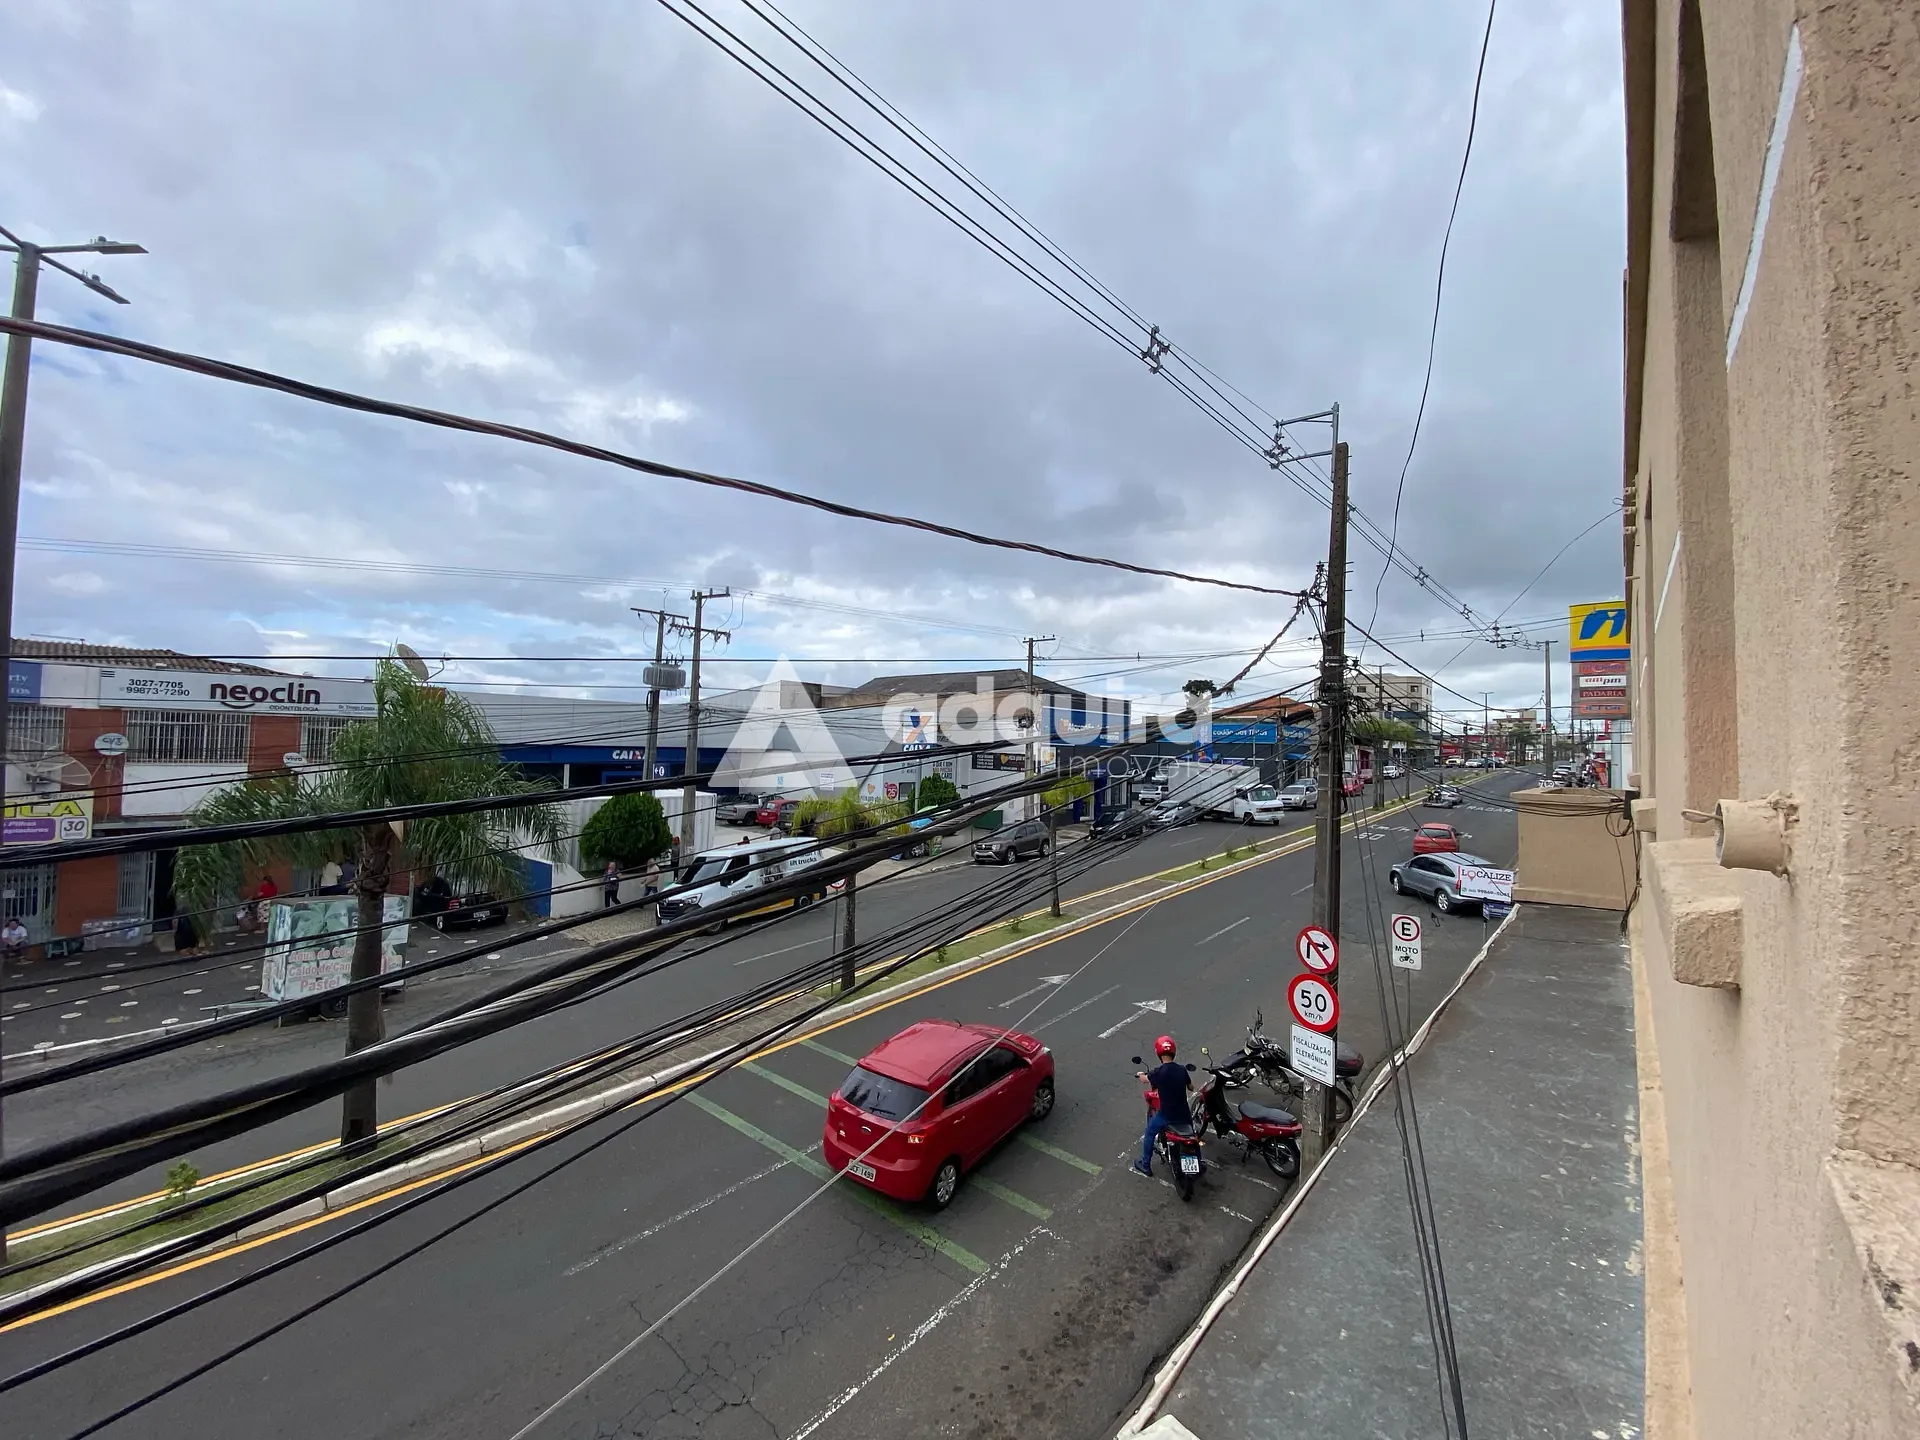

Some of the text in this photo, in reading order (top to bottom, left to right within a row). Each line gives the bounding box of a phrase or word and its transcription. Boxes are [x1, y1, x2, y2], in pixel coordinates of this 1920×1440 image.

[128, 679, 183, 689] 3027-7705
[126, 686, 190, 696] 99873-7290
[210, 682, 320, 704] neoclin
[269, 704, 319, 712] ODONTOLOGIA
[612, 750, 646, 760] CAIX
[64, 821, 85, 832] 30
[798, 857, 817, 865] trucks
[1401, 922, 1411, 937] E
[1395, 945, 1418, 955] MOTO
[300, 976, 340, 992] Pastel
[1301, 989, 1327, 1012] 50
[1304, 1010, 1324, 1022] km/h
[1293, 1036, 1331, 1056] FISCALIZAÇÃO
[1296, 1048, 1328, 1067] ELETRÔNICA
